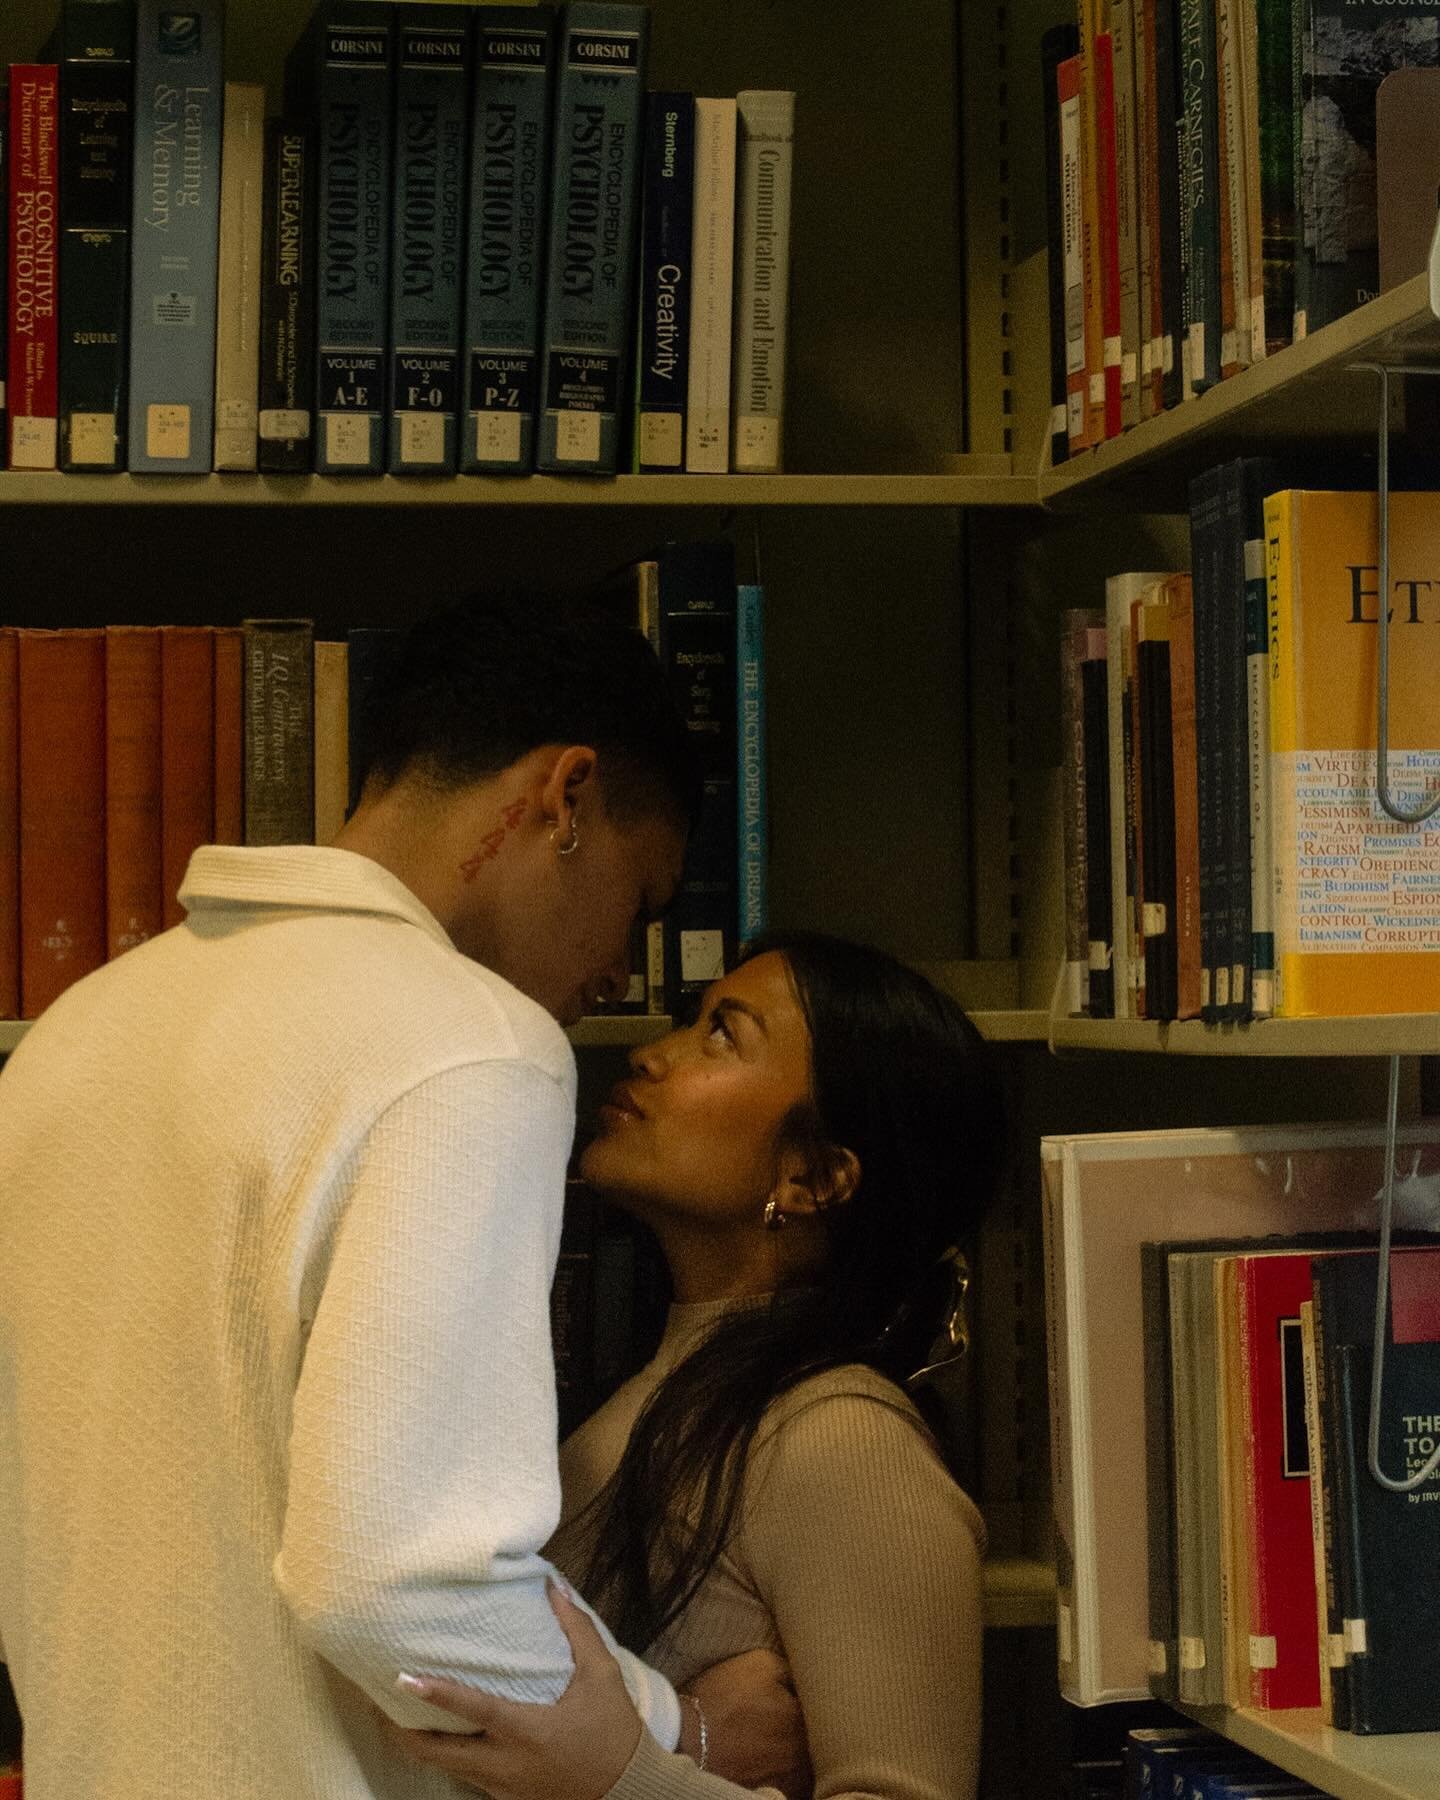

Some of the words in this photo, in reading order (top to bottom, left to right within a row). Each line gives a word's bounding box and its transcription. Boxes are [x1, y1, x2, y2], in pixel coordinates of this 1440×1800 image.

[330, 39, 385, 54] CORSINI
[408, 39, 461, 55] CORSINI
[488, 41, 541, 57] CORSINI
[577, 42, 630, 58] CORSINI
[38, 82, 54, 113] The
[154, 84, 178, 115] &
[19, 82, 36, 160] Dictionary
[1189, 59, 1206, 208] CARNEGIE'S
[38, 116, 54, 185] Blackwell
[175, 86, 210, 208] Learning
[661, 111, 679, 177] Sternberg
[21, 164, 35, 179] of
[144, 121, 176, 233] Memory
[327, 103, 359, 302] PSYCHOLOGY
[364, 120, 382, 256] ENCYCLOPEDIA
[403, 103, 436, 303] PSYCHOLOGY
[441, 121, 461, 255] ENCYCLOPEDIA
[519, 122, 538, 256] ENCYCLOPEDIA
[562, 104, 605, 303] PSYCHOLOGY
[604, 124, 625, 257] ENCYCLOPEDIA
[280, 135, 302, 286] SUPERLEARNING
[480, 104, 517, 304] PSYCHOLOGY
[753, 150, 781, 291] Communication
[15, 191, 34, 337] PSYCHOLOGY
[35, 191, 53, 318] COGNITIVE
[442, 260, 457, 286] OF
[518, 261, 533, 287] OF
[602, 262, 618, 288] OF
[651, 263, 682, 379] Creativity
[753, 298, 775, 330] and
[327, 358, 376, 369] VOLUME
[349, 371, 355, 384] 1
[401, 359, 450, 371] VOLUME
[421, 372, 430, 384] 2
[479, 359, 528, 372] VOLUME
[498, 372, 507, 385] 3
[560, 356, 608, 371] VOLUME
[579, 370, 587, 383] 4
[748, 338, 774, 413] Emotion
[333, 386, 368, 406] A-E
[408, 387, 443, 407] F-O
[485, 387, 520, 408] P-Z
[1269, 537, 1280, 680] ETHICS
[1346, 565, 1440, 623] ET
[252, 650, 265, 711] CRITICAL
[744, 661, 759, 691] THE
[1251, 664, 1260, 791] ENCYCLOPEDIA
[252, 716, 265, 782] READINGS
[744, 700, 761, 826] ENCYCLOPEDIA
[1314, 757, 1370, 771] VIRTUE
[1334, 821, 1421, 834] APARTHEID
[1364, 836, 1421, 848] PROMISES
[747, 832, 760, 855] OF
[1304, 840, 1360, 855] RACISM
[747, 862, 761, 928] DREAMS
[1324, 880, 1389, 892] BUDDHISM
[1299, 915, 1366, 926] CONTROL
[1408, 1493, 1420, 1503] by
